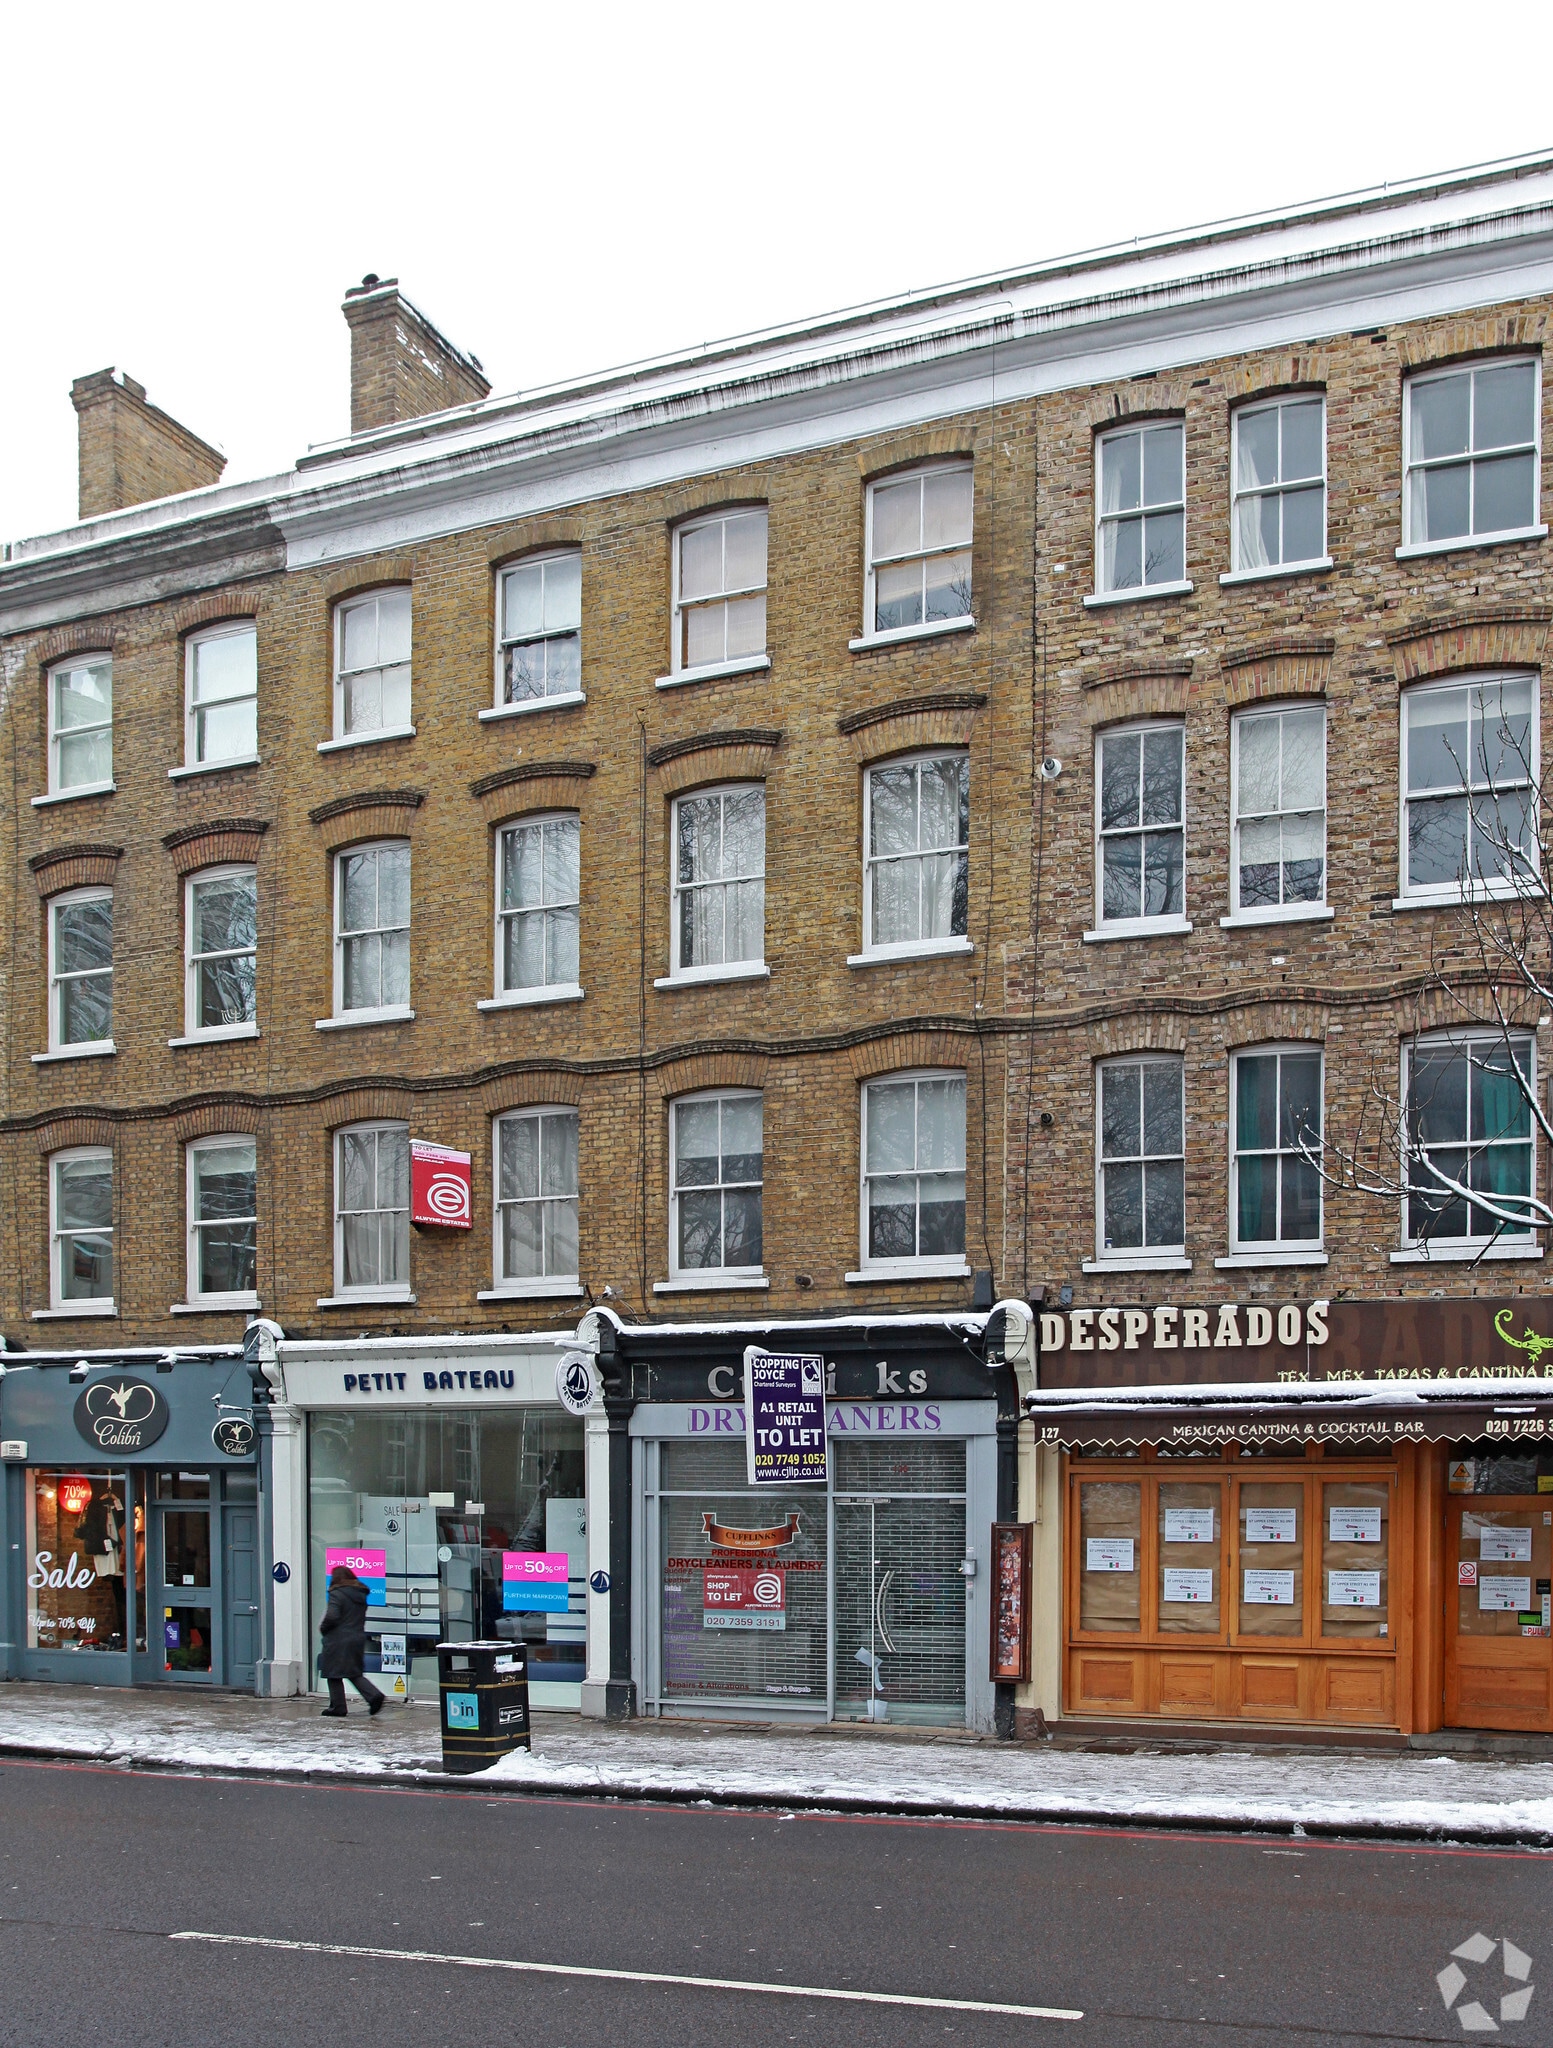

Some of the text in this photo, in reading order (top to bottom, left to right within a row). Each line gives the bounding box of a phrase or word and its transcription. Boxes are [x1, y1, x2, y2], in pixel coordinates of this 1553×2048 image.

[1040, 1304, 1330, 1352] DESPERADOS
[753, 1358, 799, 1369] COPPING
[754, 1370, 785, 1380] JOYCE
[1277, 1370, 1309, 1382] TEX
[1326, 1369, 1364, 1381] MEX
[1374, 1367, 1432, 1380] TAPAS
[1437, 1367, 1450, 1379] &
[1456, 1365, 1538, 1378] CANTINA
[343, 1370, 514, 1392] PETIT BATEAU
[760, 1402, 817, 1412] A1 RETAIL
[776, 1415, 803, 1426] UNIT
[1486, 1420, 1509, 1433] 020
[1513, 1420, 1544, 1432] 7226
[1041, 1427, 1059, 1439] 127
[1173, 1421, 1424, 1436] MEXICAN CANTINA & COCKTAIL BAR
[98, 1424, 141, 1446] Colibri
[756, 1428, 822, 1446] TO LET
[226, 1442, 247, 1454] Colibri
[756, 1453, 826, 1466] 020 7749 1052
[757, 1466, 824, 1478] www.cjllp.co.uk
[64, 1485, 86, 1498] 70%
[384, 1506, 400, 1516] SALE
[726, 1532, 776, 1540] CUFFLINKS
[711, 1549, 778, 1558] PROFESSIONAL
[346, 1556, 372, 1569] 50%
[524, 1561, 553, 1573] 50%
[668, 1558, 824, 1570] DRYCLEANERS & LAUNDRY
[28, 1550, 96, 1589] Sale
[707, 1593, 742, 1601] TO LET
[58, 1617, 75, 1630] 70%
[706, 1617, 725, 1625] 020
[729, 1618, 753, 1626] 7359
[666, 1680, 695, 1689] Repairs
[706, 1682, 749, 1690] Alterations
[450, 1700, 474, 1716] bin
